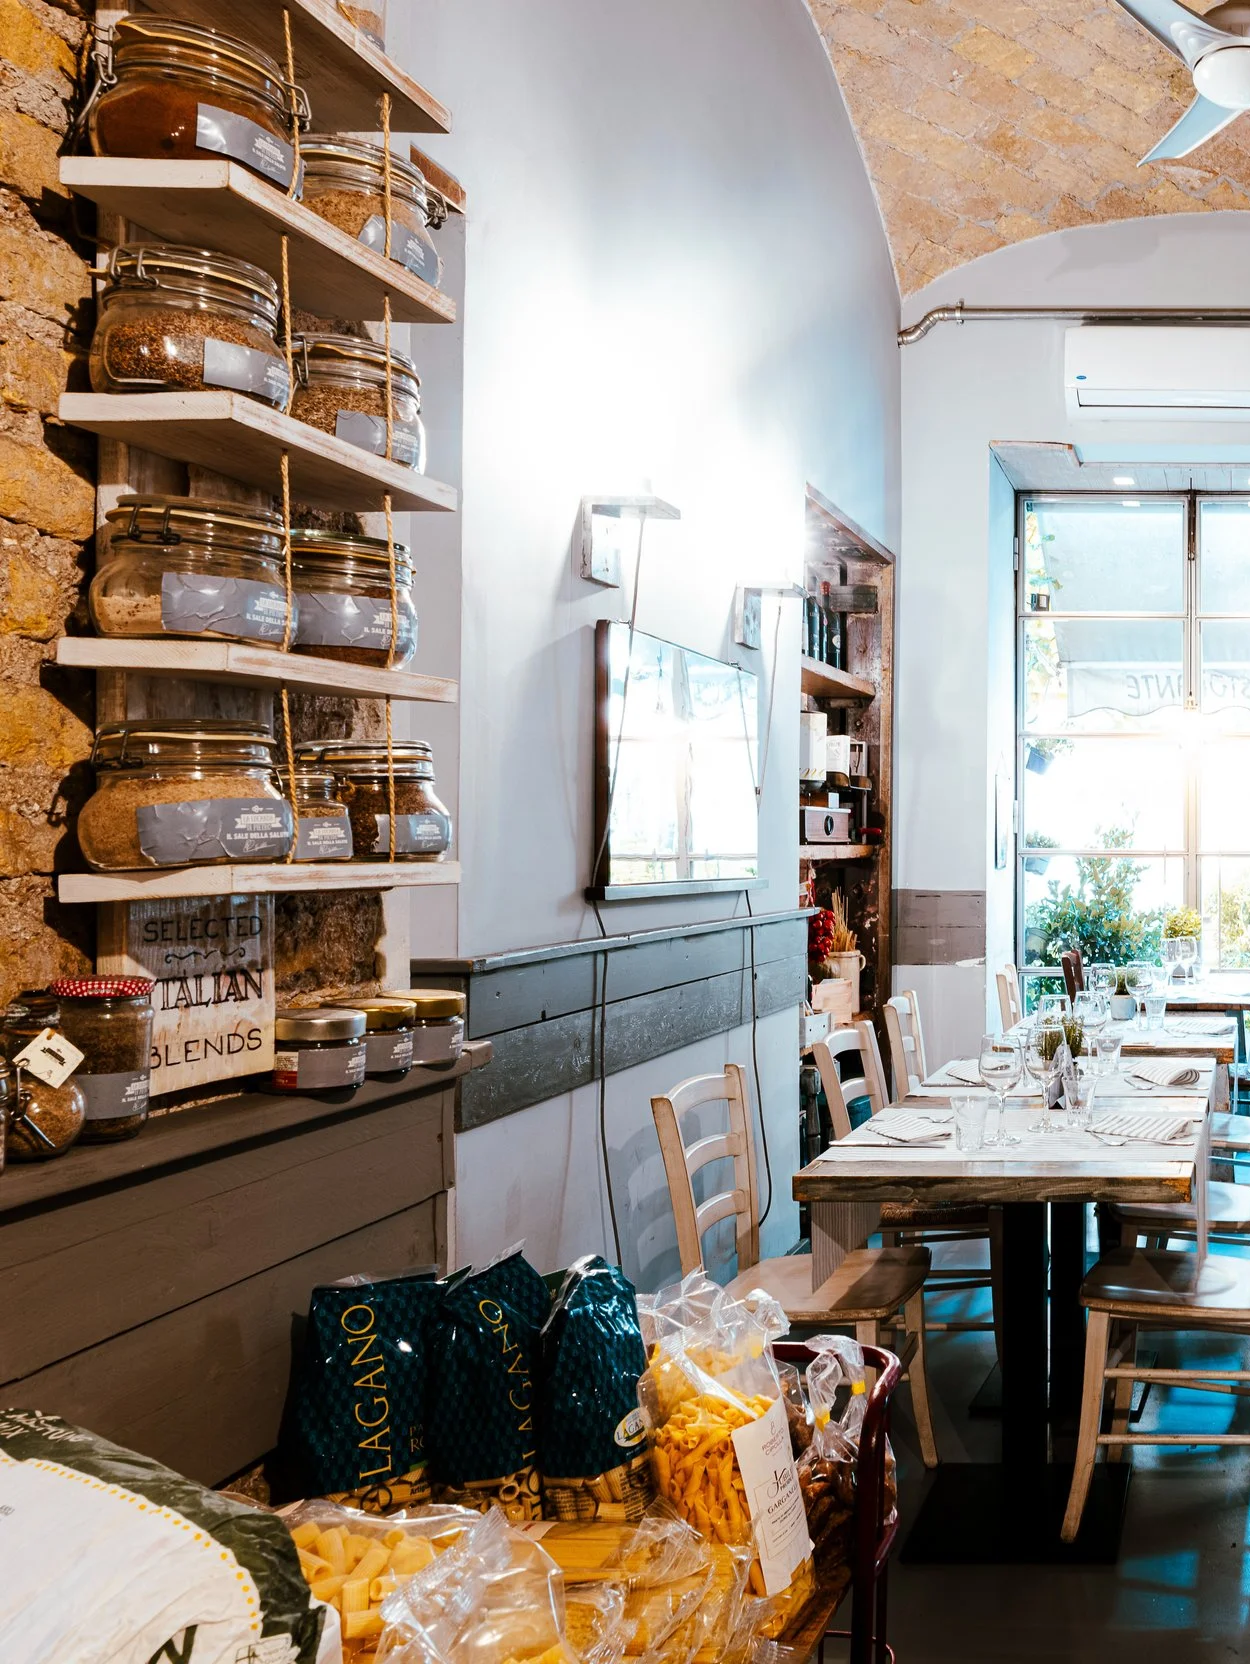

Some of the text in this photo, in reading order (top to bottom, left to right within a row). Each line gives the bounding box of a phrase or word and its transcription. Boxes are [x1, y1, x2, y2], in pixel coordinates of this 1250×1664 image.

[233, 832, 249, 840] SALE
[250, 832, 268, 840] DELLA
[143, 916, 262, 942] SELECTED
[154, 968, 264, 1011] TALIAN
[341, 1304, 392, 1481] LAGANO
